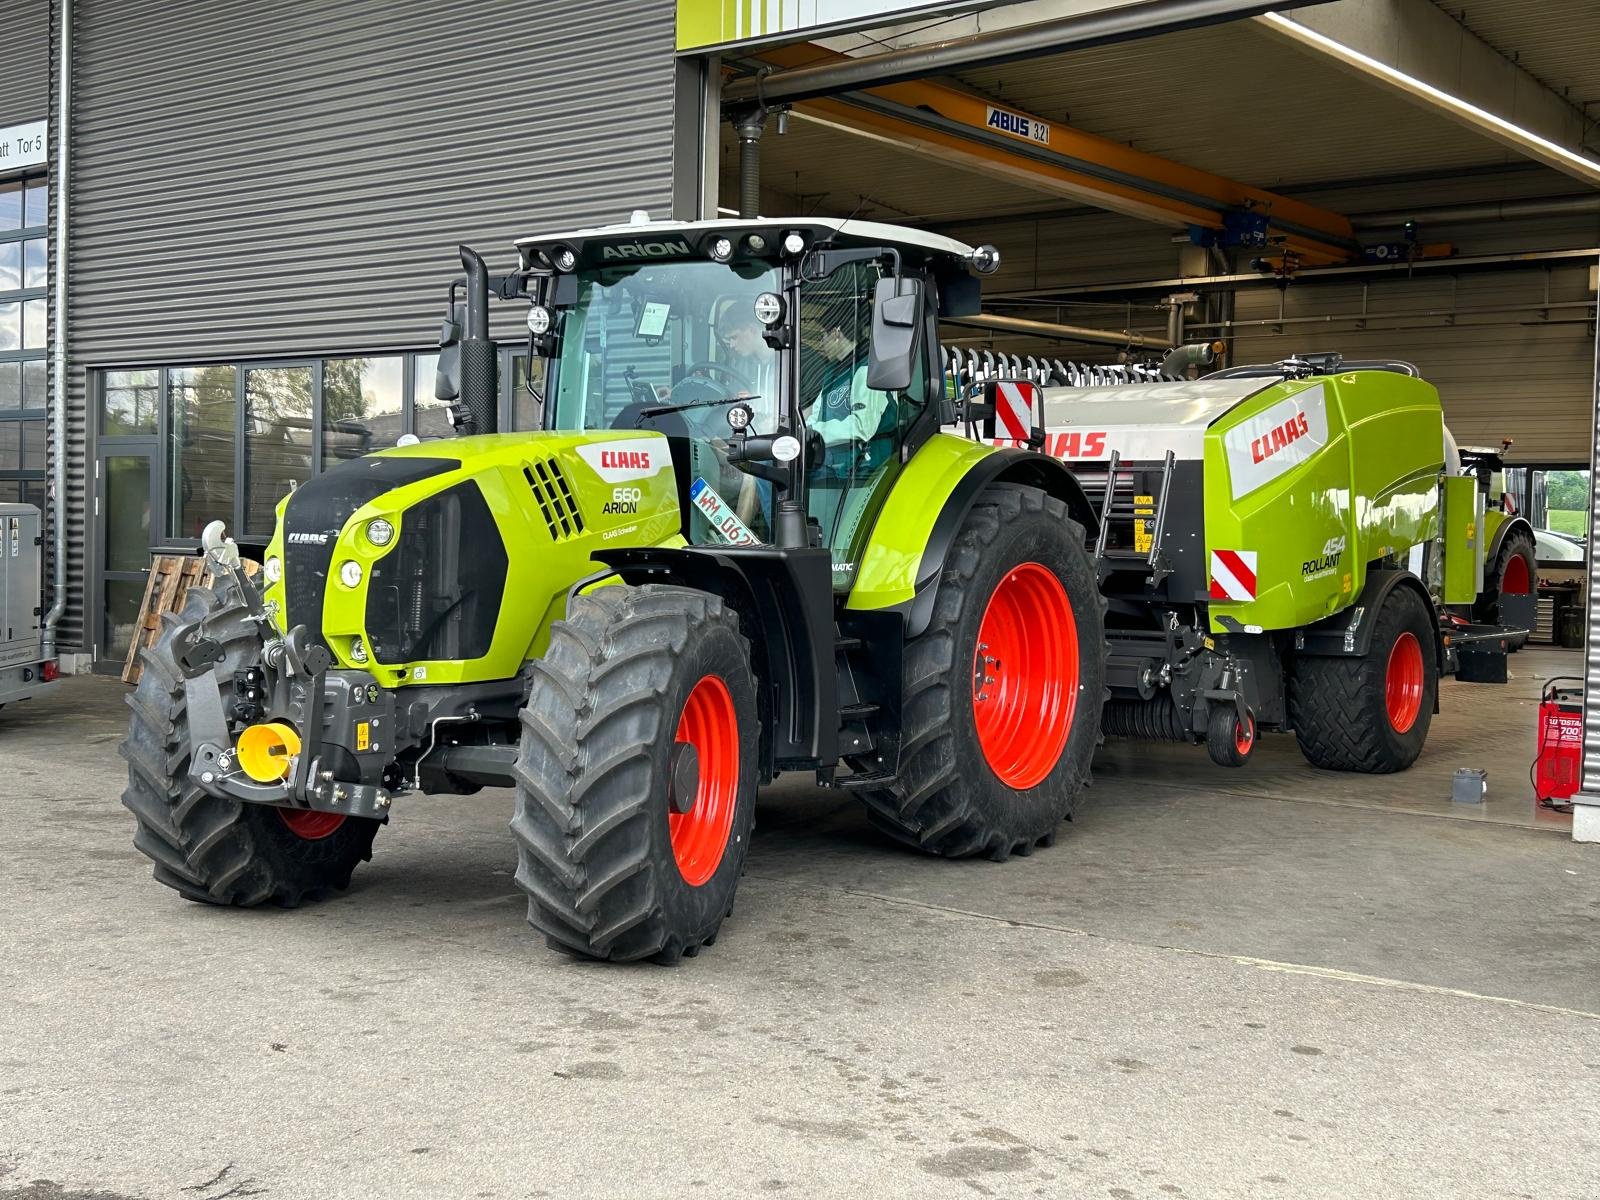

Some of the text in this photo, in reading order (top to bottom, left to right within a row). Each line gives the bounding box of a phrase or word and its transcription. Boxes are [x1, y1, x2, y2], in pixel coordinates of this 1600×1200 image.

[988, 109, 1029, 136] ABUS
[17, 138, 33, 154] Tor
[35, 135, 42, 151] 5
[1251, 411, 1309, 464] CLAAS
[601, 451, 650, 469] CLAAS
[612, 487, 642, 502] 660
[602, 502, 637, 514] ARION
[1322, 535, 1346, 556] 454
[1301, 552, 1341, 575] ROLLANT
